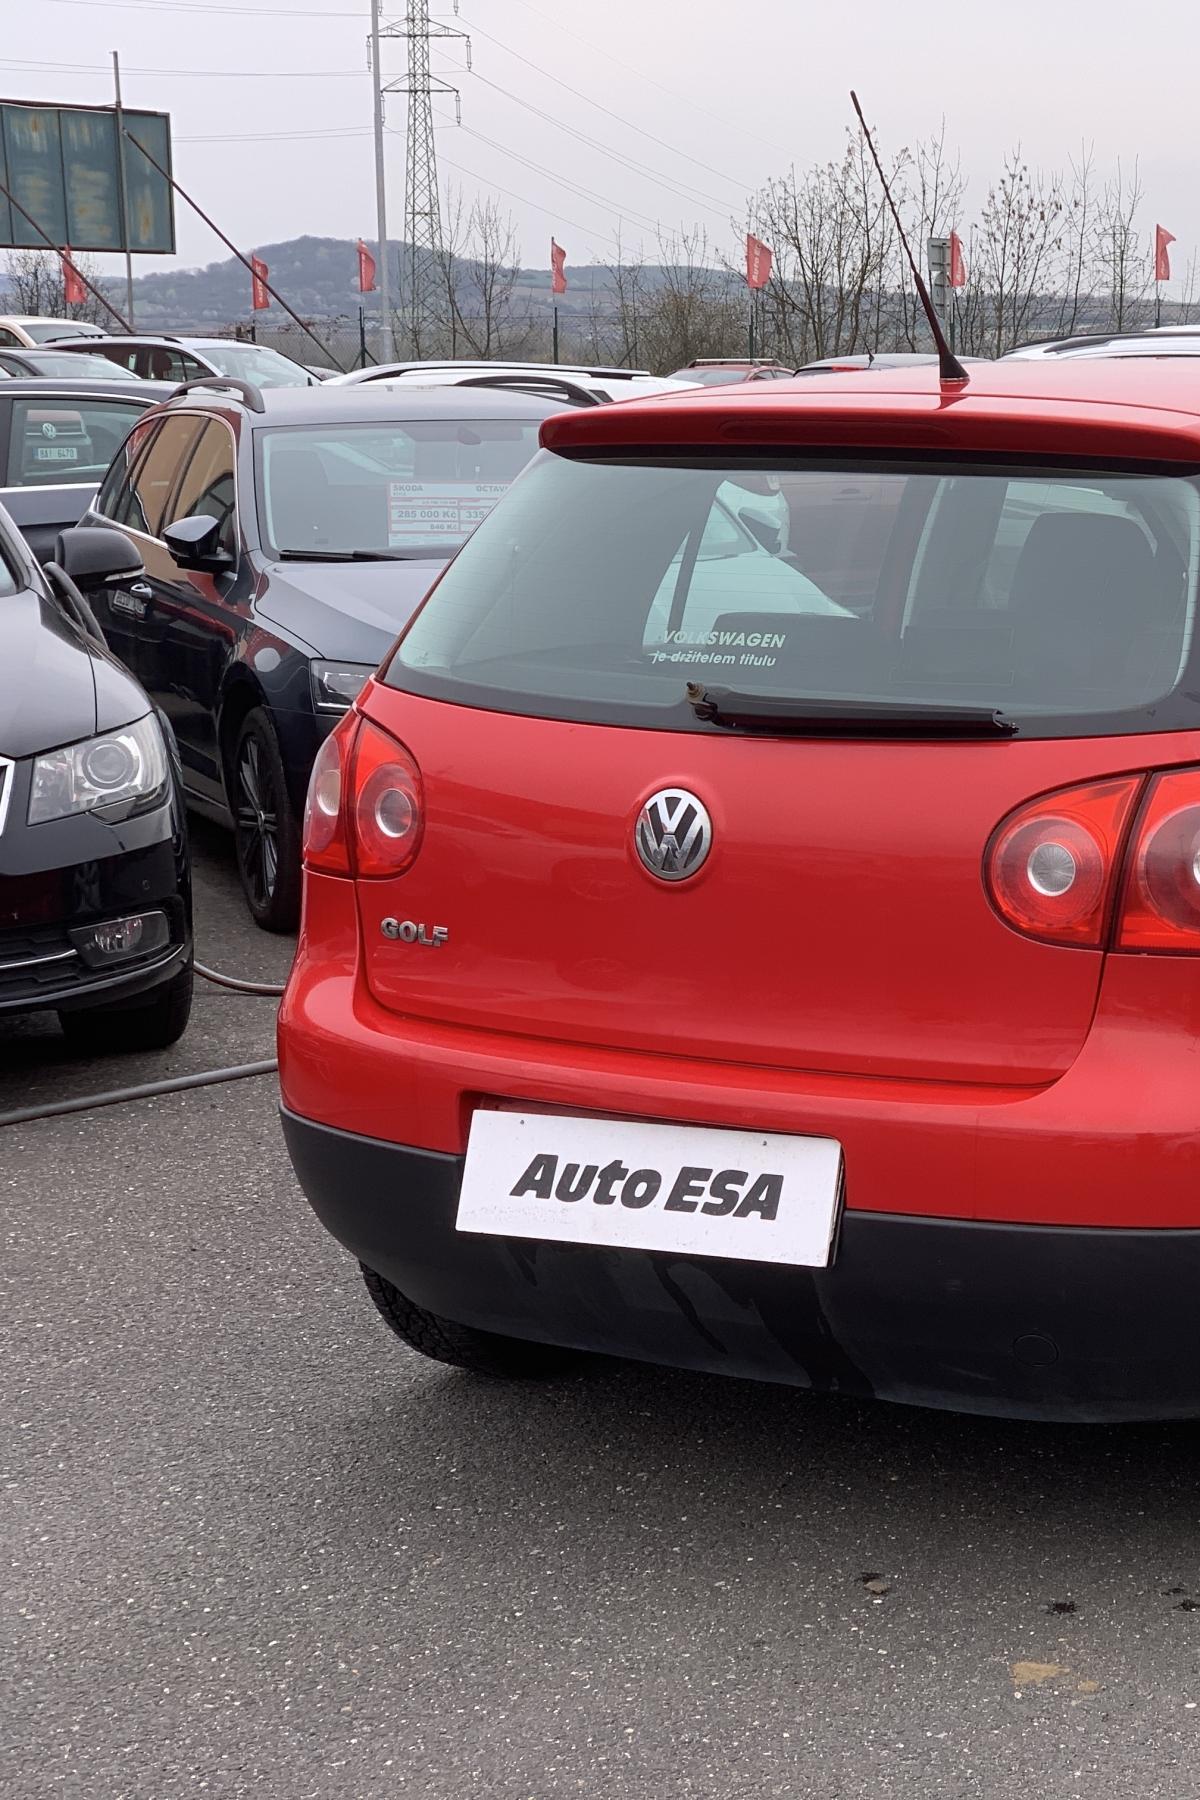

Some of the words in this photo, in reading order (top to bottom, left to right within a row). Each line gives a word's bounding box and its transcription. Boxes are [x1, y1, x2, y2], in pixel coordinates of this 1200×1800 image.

[419, 510, 440, 519] 000
[662, 630, 786, 649] VOLKSWAGEN
[652, 650, 668, 664] je
[671, 650, 736, 665] držitelem
[739, 654, 776, 667] titulu
[381, 917, 448, 946] GOLF
[509, 1153, 663, 1210] Auto
[663, 1165, 785, 1221] ESA
